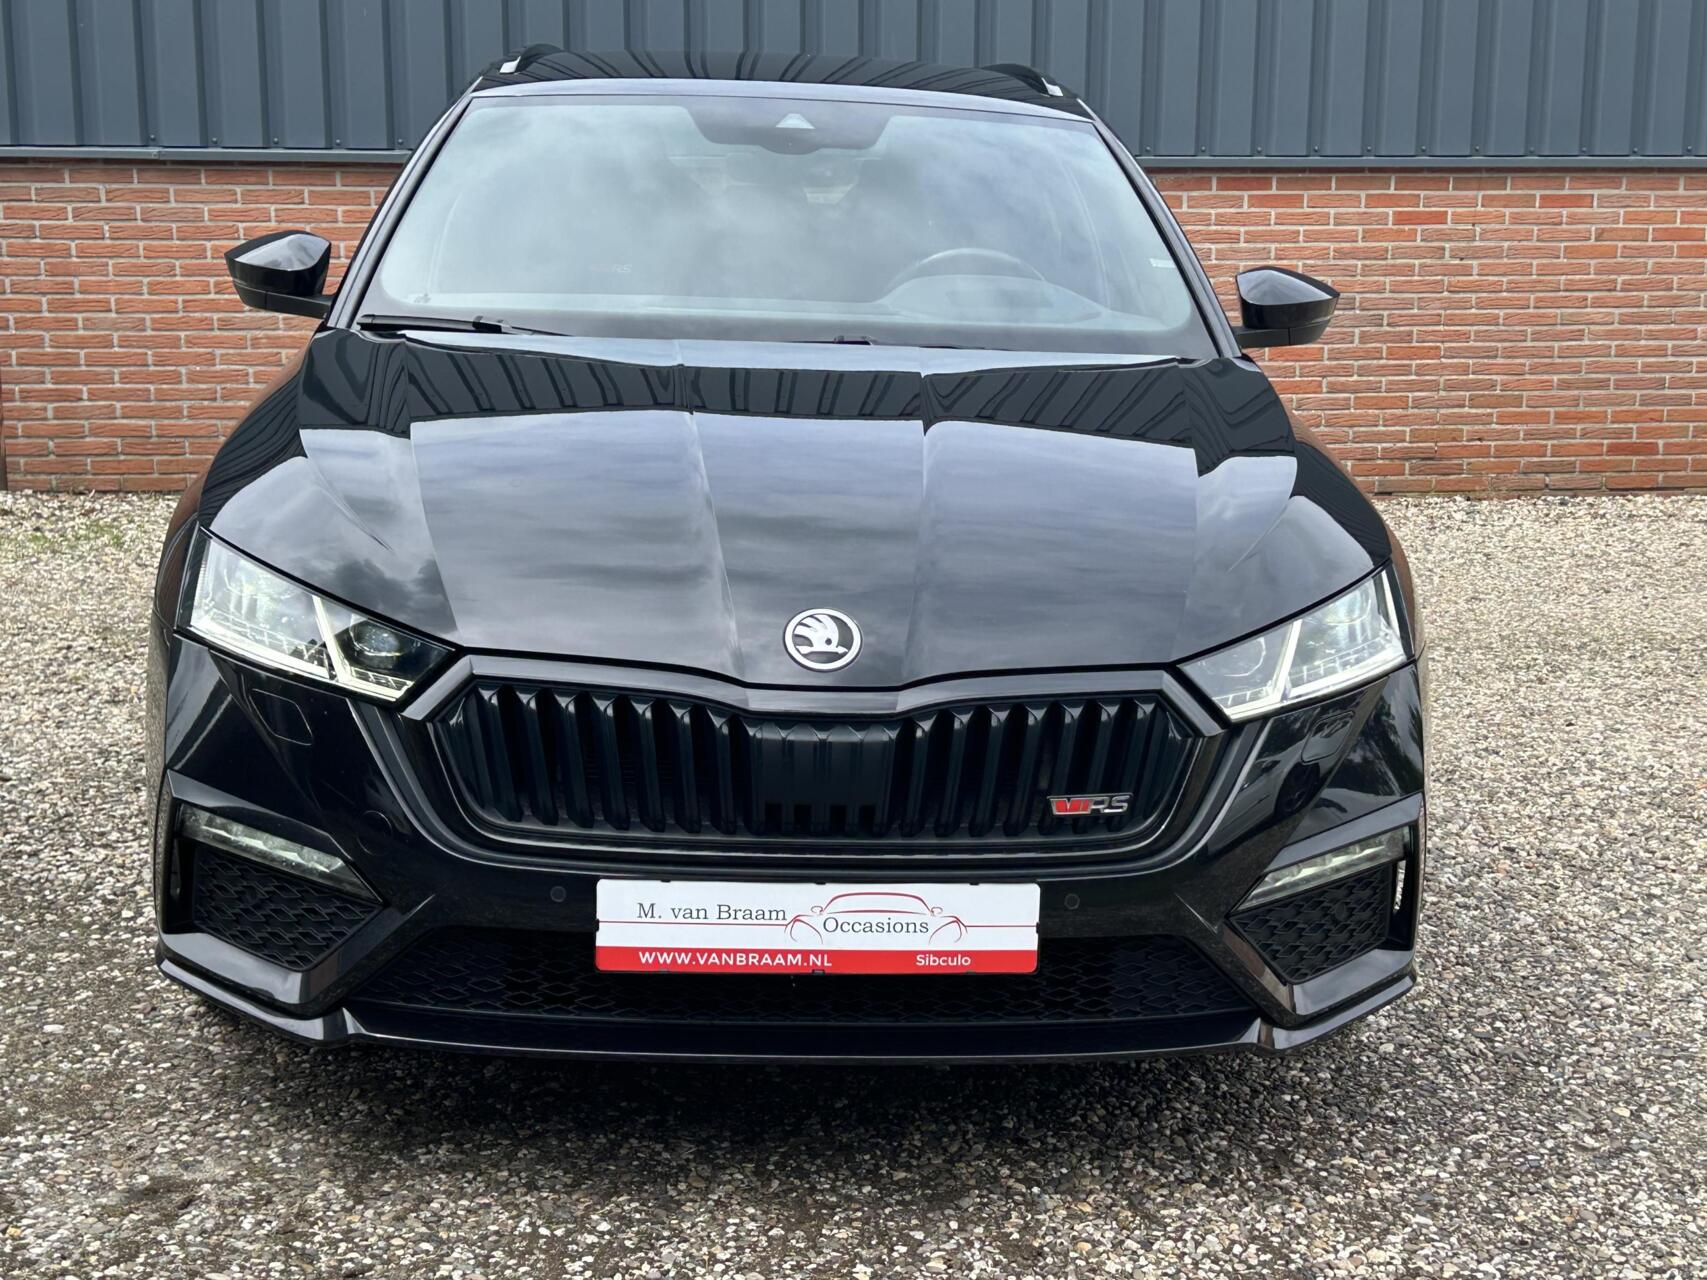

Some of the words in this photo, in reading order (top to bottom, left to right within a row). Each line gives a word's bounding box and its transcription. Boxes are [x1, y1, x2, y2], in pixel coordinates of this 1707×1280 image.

[637, 902, 662, 920] M.
[671, 905, 708, 920] van
[716, 904, 787, 921] Braam
[823, 917, 930, 934] Occasions
[638, 951, 833, 967] WWW.VANBRAAM.NL
[915, 953, 972, 968] Sibculo
